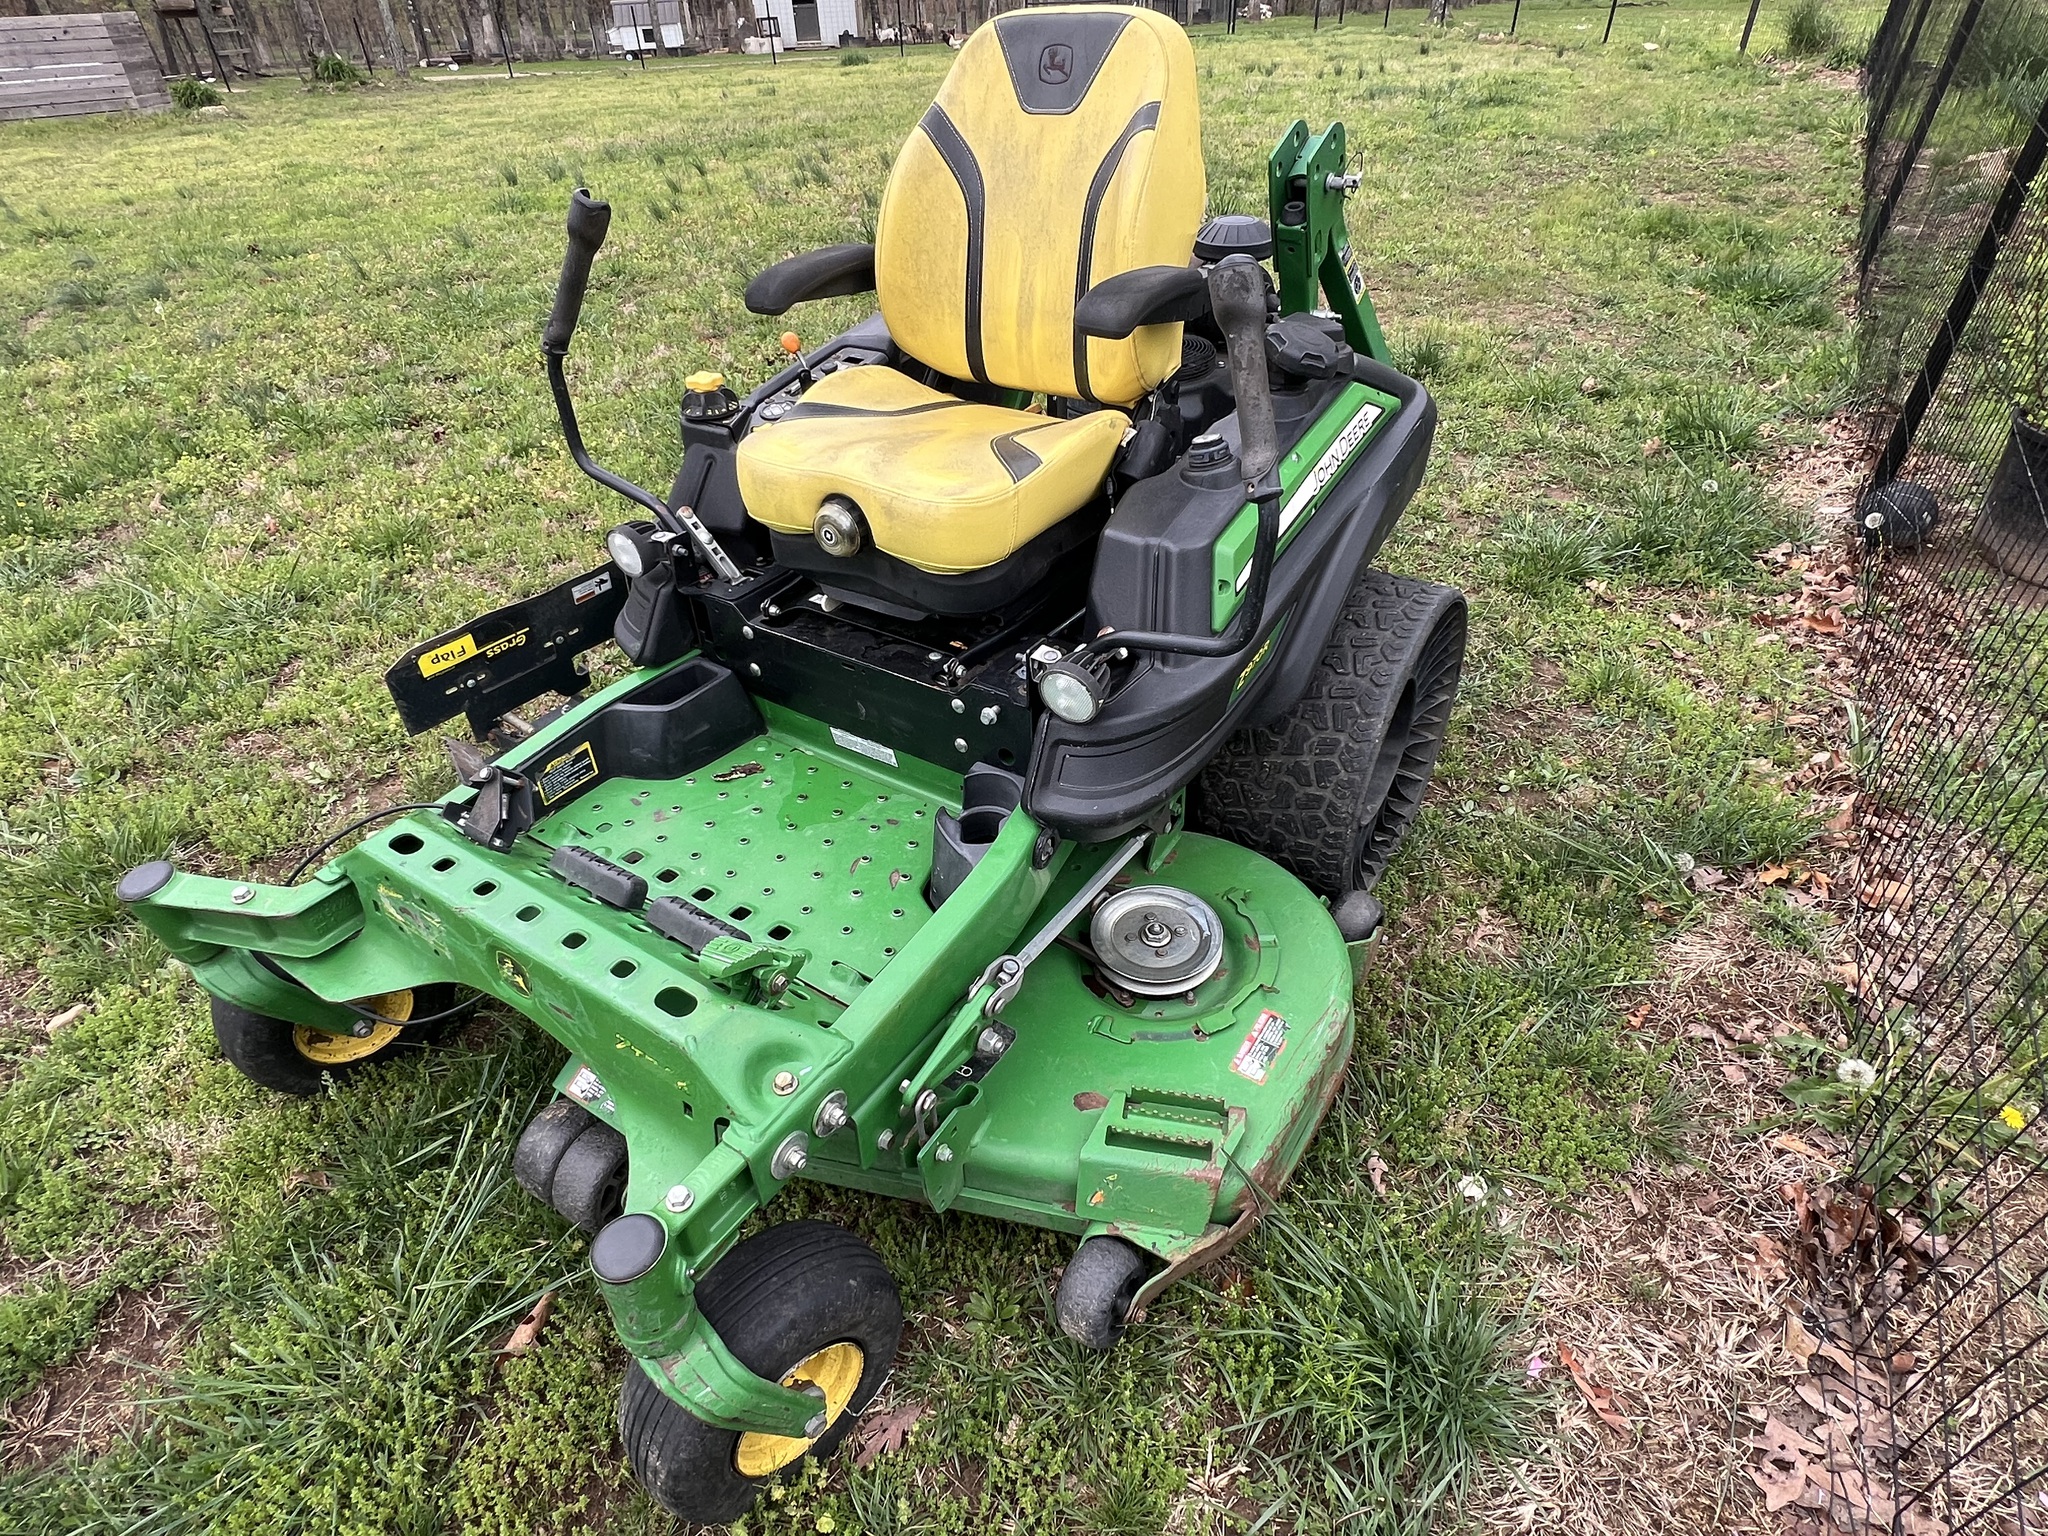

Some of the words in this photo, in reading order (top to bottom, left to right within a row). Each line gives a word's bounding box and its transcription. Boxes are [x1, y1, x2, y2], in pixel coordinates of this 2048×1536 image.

[1313, 448, 1340, 493] JOHN
[1339, 411, 1370, 457] DEERE
[430, 645, 467, 665] Flap
[485, 633, 527, 658] Grass
